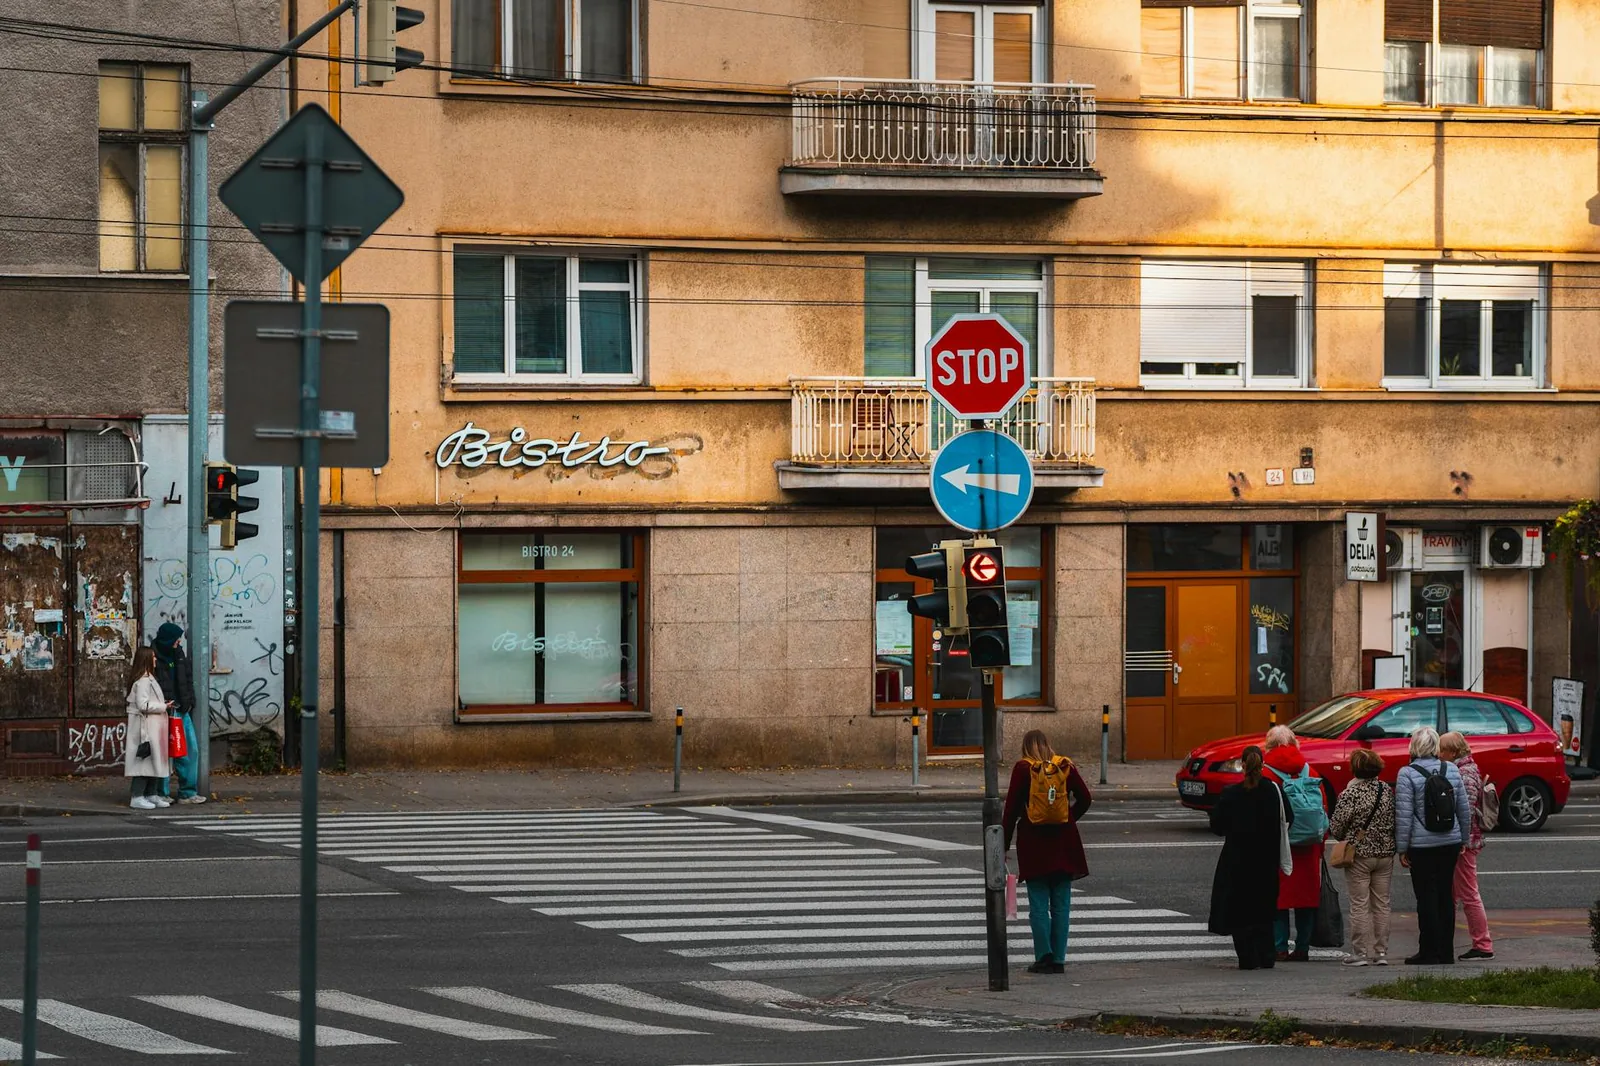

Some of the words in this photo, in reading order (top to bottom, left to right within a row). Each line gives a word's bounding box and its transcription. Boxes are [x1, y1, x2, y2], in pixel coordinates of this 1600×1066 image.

[936, 347, 1019, 386] STOP
[435, 422, 670, 469] Bistro
[1270, 471, 1281, 482] 24
[521, 545, 558, 558] BISTRO
[561, 545, 575, 557] 24
[1349, 543, 1376, 560] DELIA
[1422, 587, 1450, 598] OPEN
